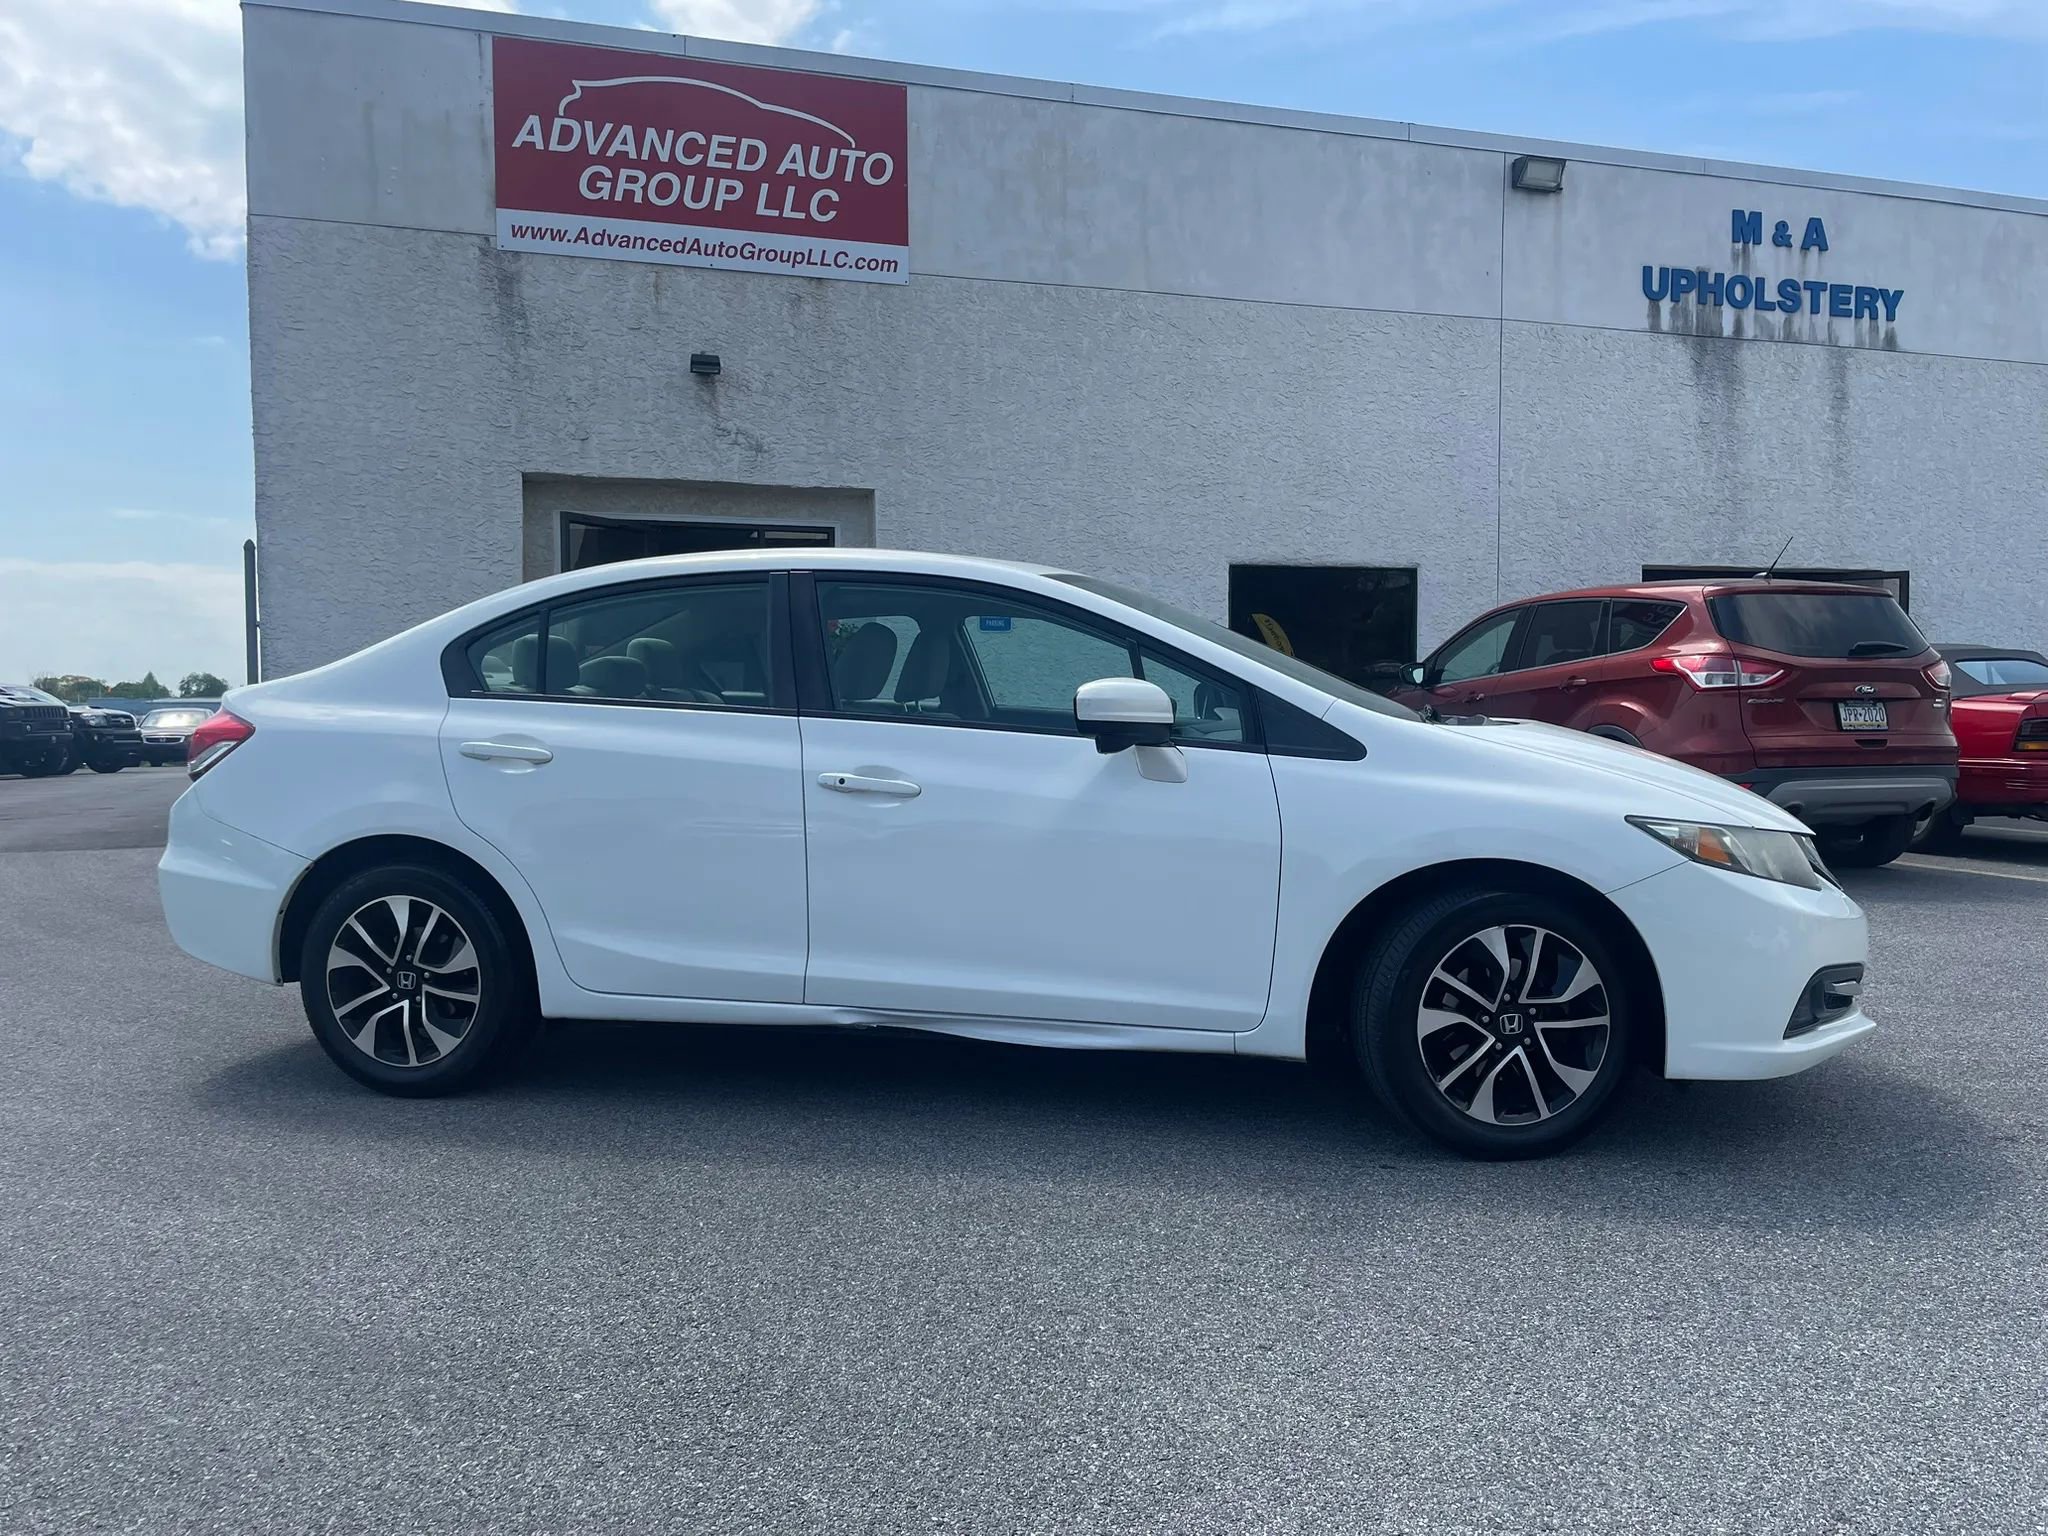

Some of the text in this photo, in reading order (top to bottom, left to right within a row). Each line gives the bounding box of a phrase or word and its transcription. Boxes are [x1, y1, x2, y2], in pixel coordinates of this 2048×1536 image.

[512, 114, 894, 186] ADVANCED AUTO
[578, 165, 840, 223] GROUP LLC
[511, 223, 899, 274] www.AdvancedAutoGroupLLC.com
[1731, 209, 1829, 251] M & A
[1642, 265, 1904, 321] UPHOLSTERY
